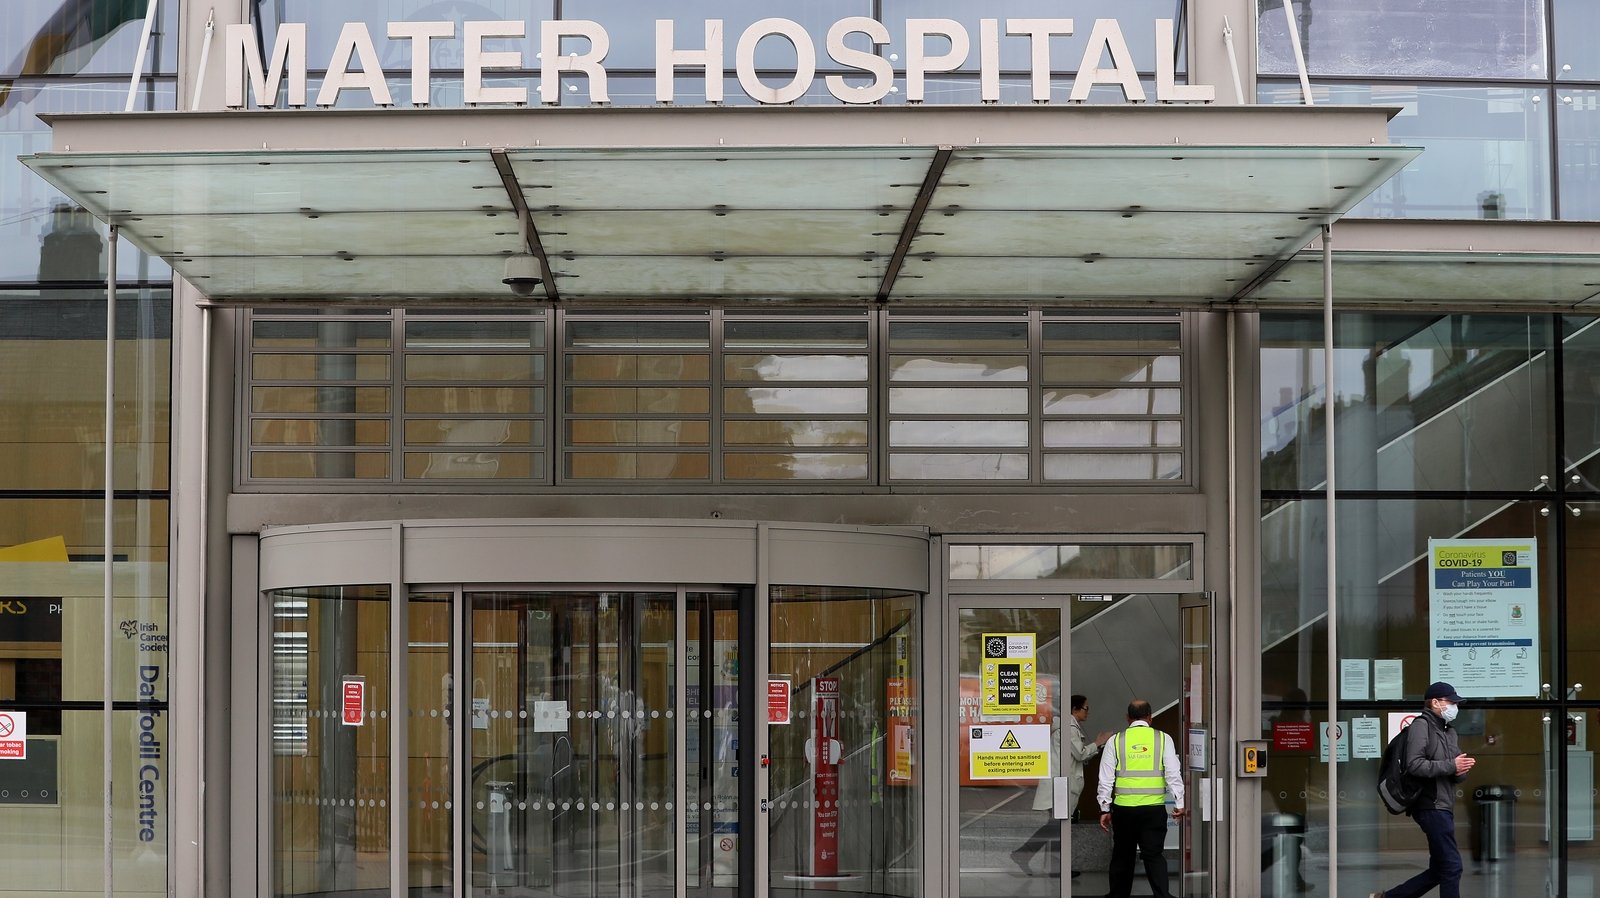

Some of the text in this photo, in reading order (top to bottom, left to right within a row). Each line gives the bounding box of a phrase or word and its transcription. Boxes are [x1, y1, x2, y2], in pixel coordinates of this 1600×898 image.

[226, 17, 1215, 106] MATER HOSPITAL
[1438, 550, 1486, 558] Coronavirus
[1439, 559, 1482, 567] COVID-19
[1467, 580, 1480, 589] Play
[140, 623, 158, 631] Irish
[139, 666, 160, 842] Daffodil Centre
